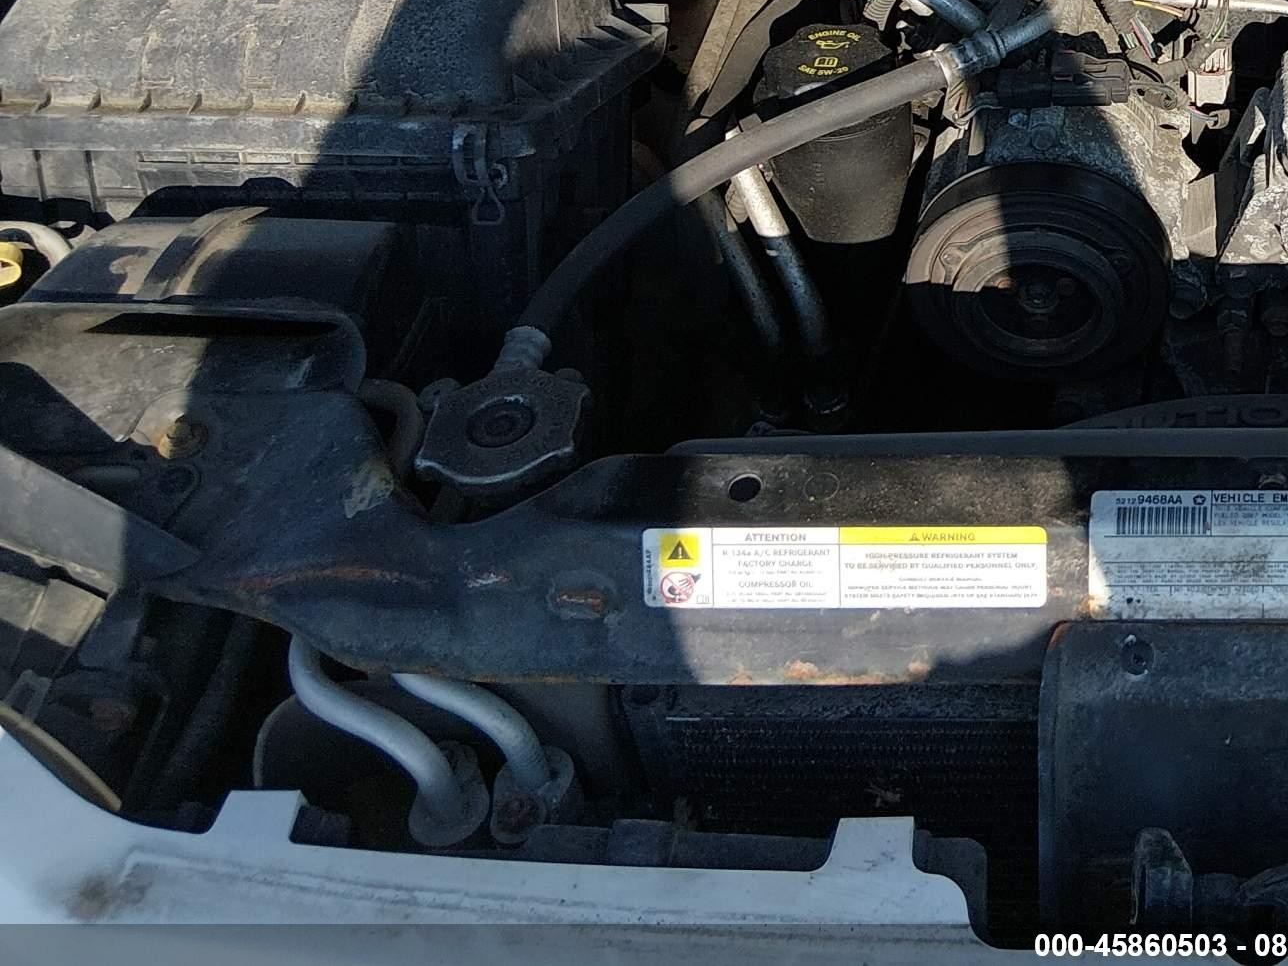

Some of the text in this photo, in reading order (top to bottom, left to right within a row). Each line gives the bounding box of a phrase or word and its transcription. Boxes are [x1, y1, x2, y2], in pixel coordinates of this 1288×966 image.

[808, 30, 861, 42] ENGINE OIL
[798, 64, 849, 76] SAE 5W-20
[1213, 494, 1265, 503] VEHICLE
[744, 533, 807, 542] ATTENTION
[922, 533, 976, 542] WARNING
[738, 580, 814, 588] COMPRESSOR OIL
